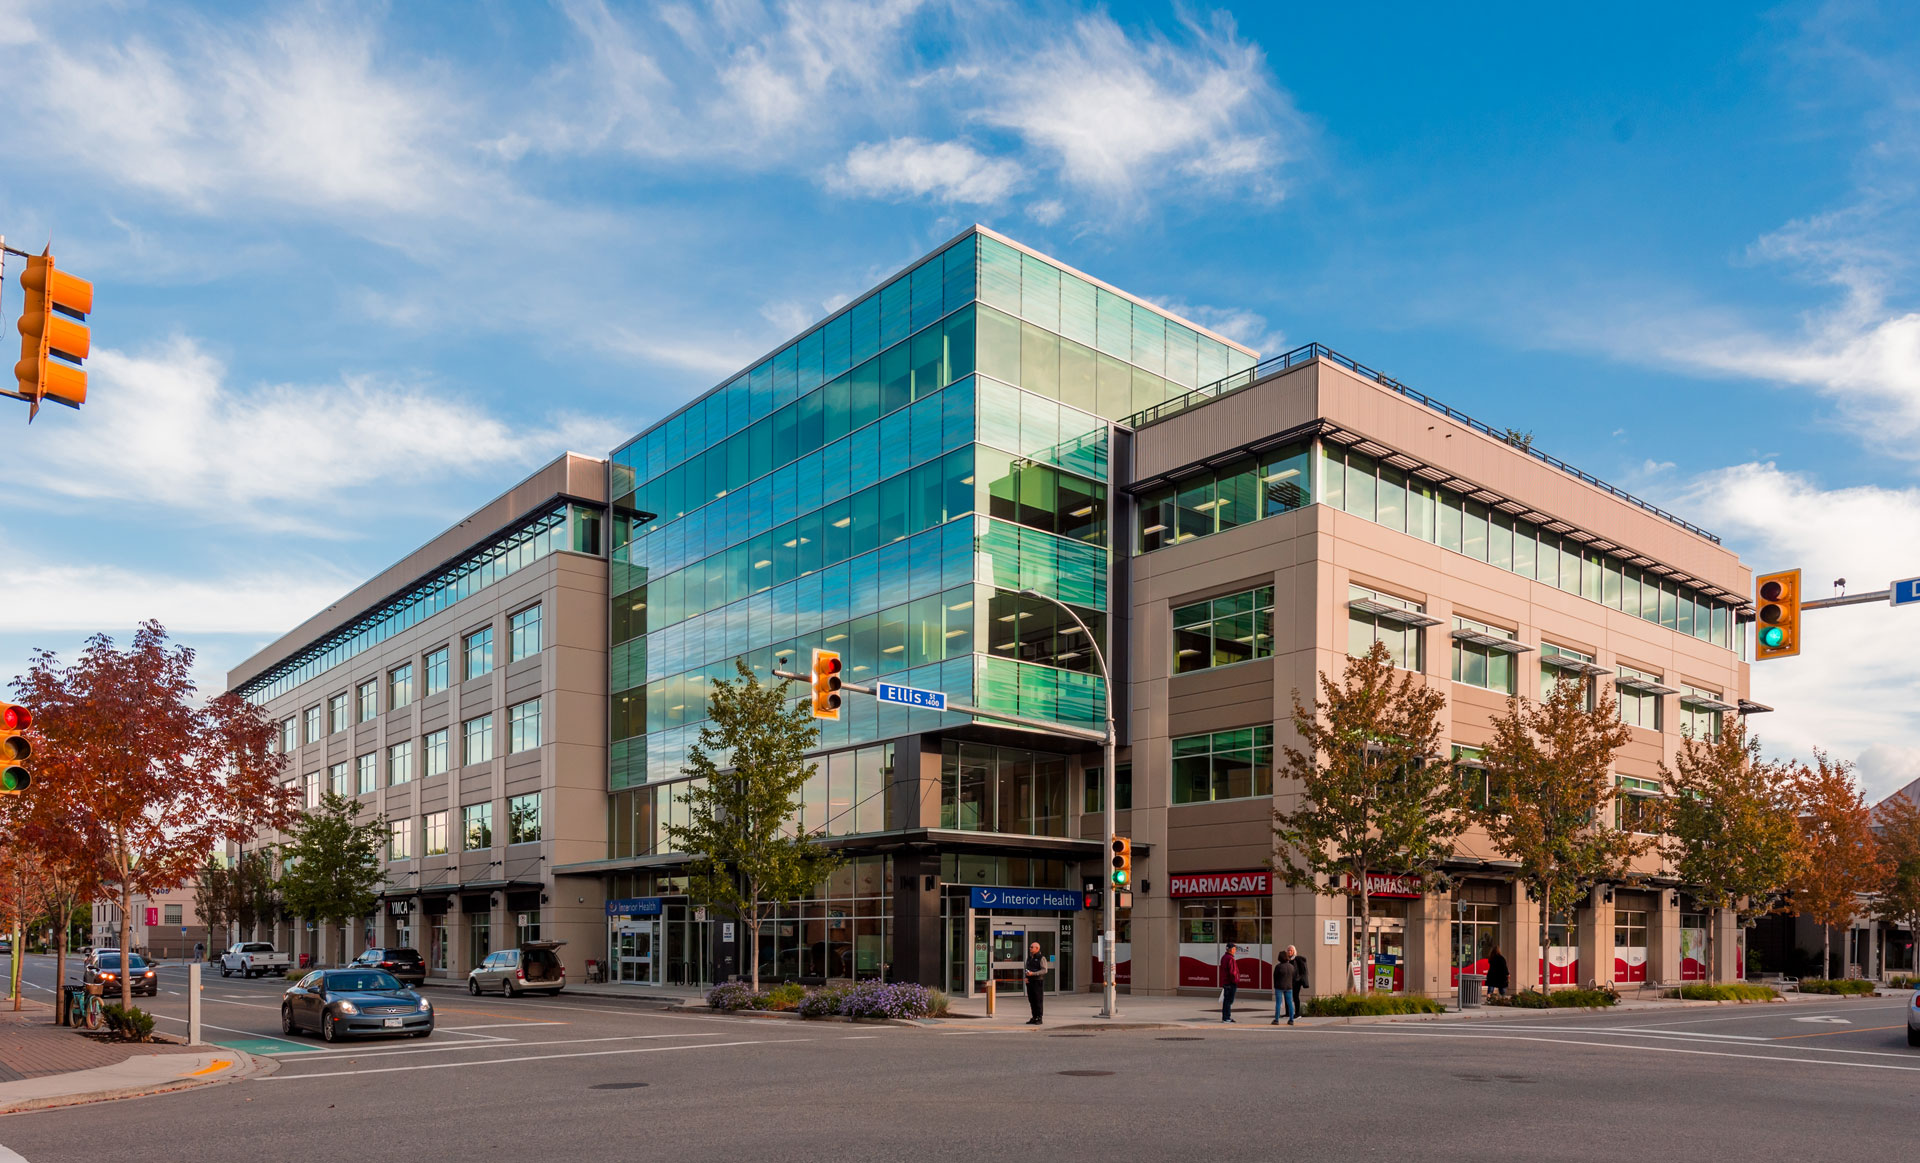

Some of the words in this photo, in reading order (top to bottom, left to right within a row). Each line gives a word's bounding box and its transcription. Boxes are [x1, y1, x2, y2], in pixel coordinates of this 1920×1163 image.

[888, 687, 922, 704] Ellis
[929, 693, 936, 701] St
[925, 699, 940, 707] 1400
[1171, 875, 1266, 894] PHARMASAVE
[1002, 892, 1040, 905] Interior
[1043, 893, 1075, 906] Health
[391, 901, 408, 915] YMCA
